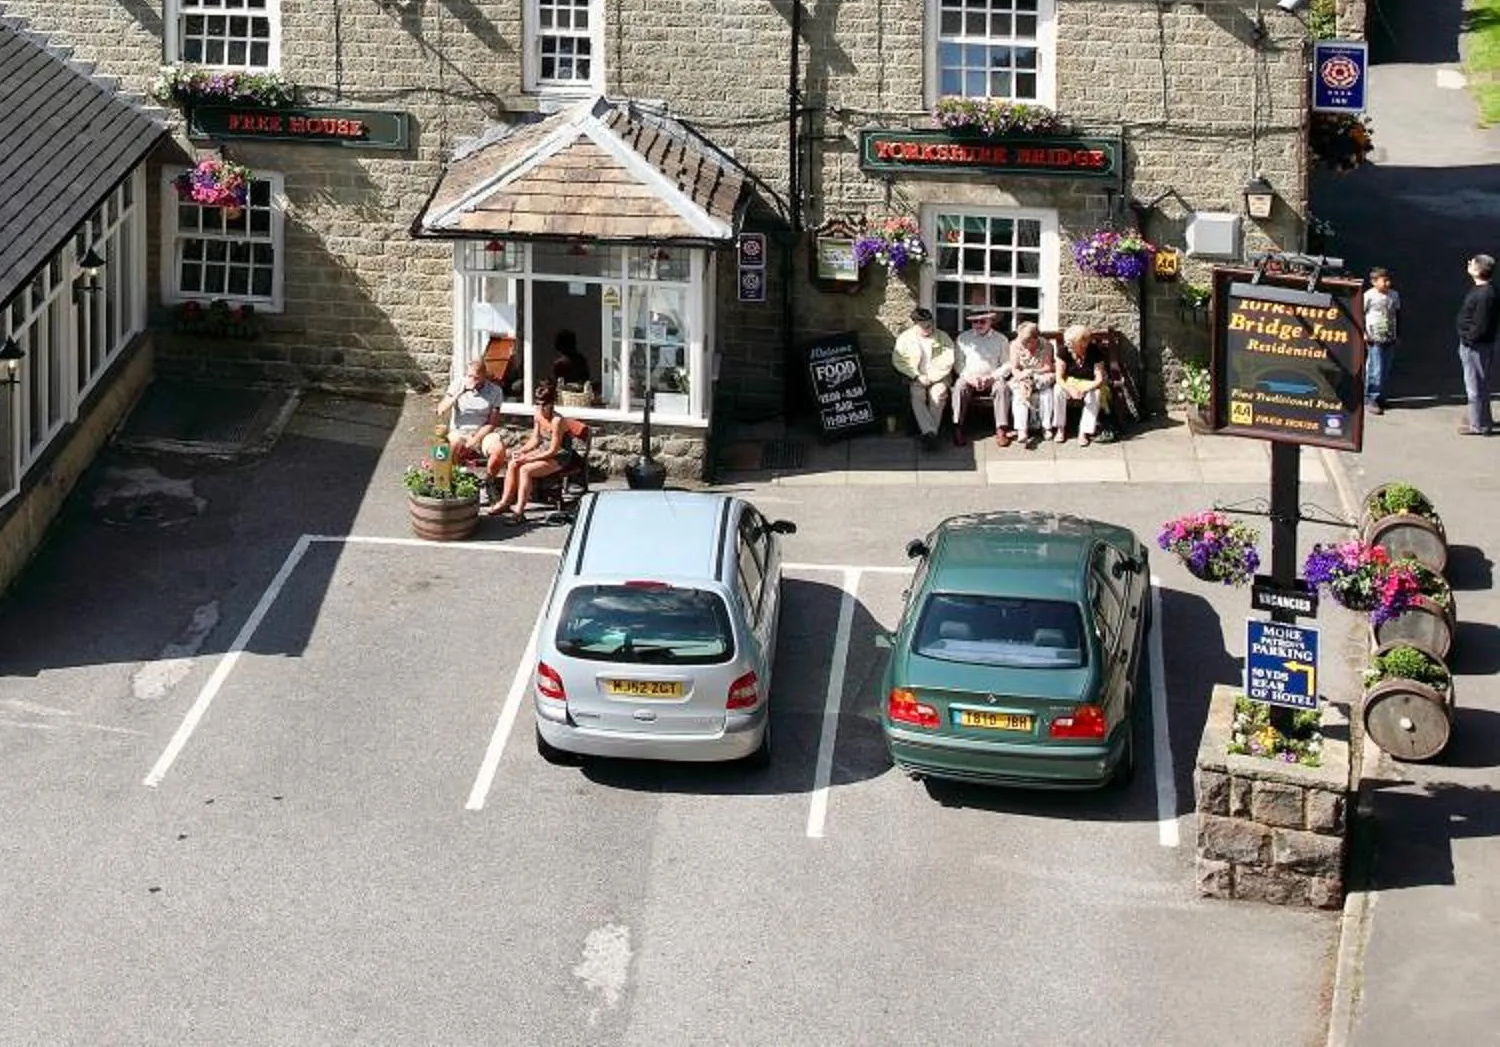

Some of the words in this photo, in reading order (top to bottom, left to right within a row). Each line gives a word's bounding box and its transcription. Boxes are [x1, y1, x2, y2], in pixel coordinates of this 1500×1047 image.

[228, 113, 283, 133] FREE
[287, 116, 365, 137] HOUSE
[874, 140, 1009, 164] YORKSHIRE
[1015, 147, 1106, 167] BRIDGE
[1228, 312, 1303, 340] Bridge
[1309, 322, 1348, 343] Inn
[1245, 338, 1328, 359] Residential
[815, 361, 857, 381] FOOD
[1255, 392, 1314, 409] Traditional
[1233, 404, 1251, 417] AA
[1259, 592, 1311, 612] VACANCIES
[1262, 625, 1303, 641] MORE
[1252, 642, 1313, 662] PARKING
[1260, 636, 1305, 650] PATRONS
[1252, 678, 1285, 691] REAR
[1265, 668, 1289, 682] YDS
[1251, 688, 1269, 698] OF
[1271, 691, 1315, 706] HOTEL
